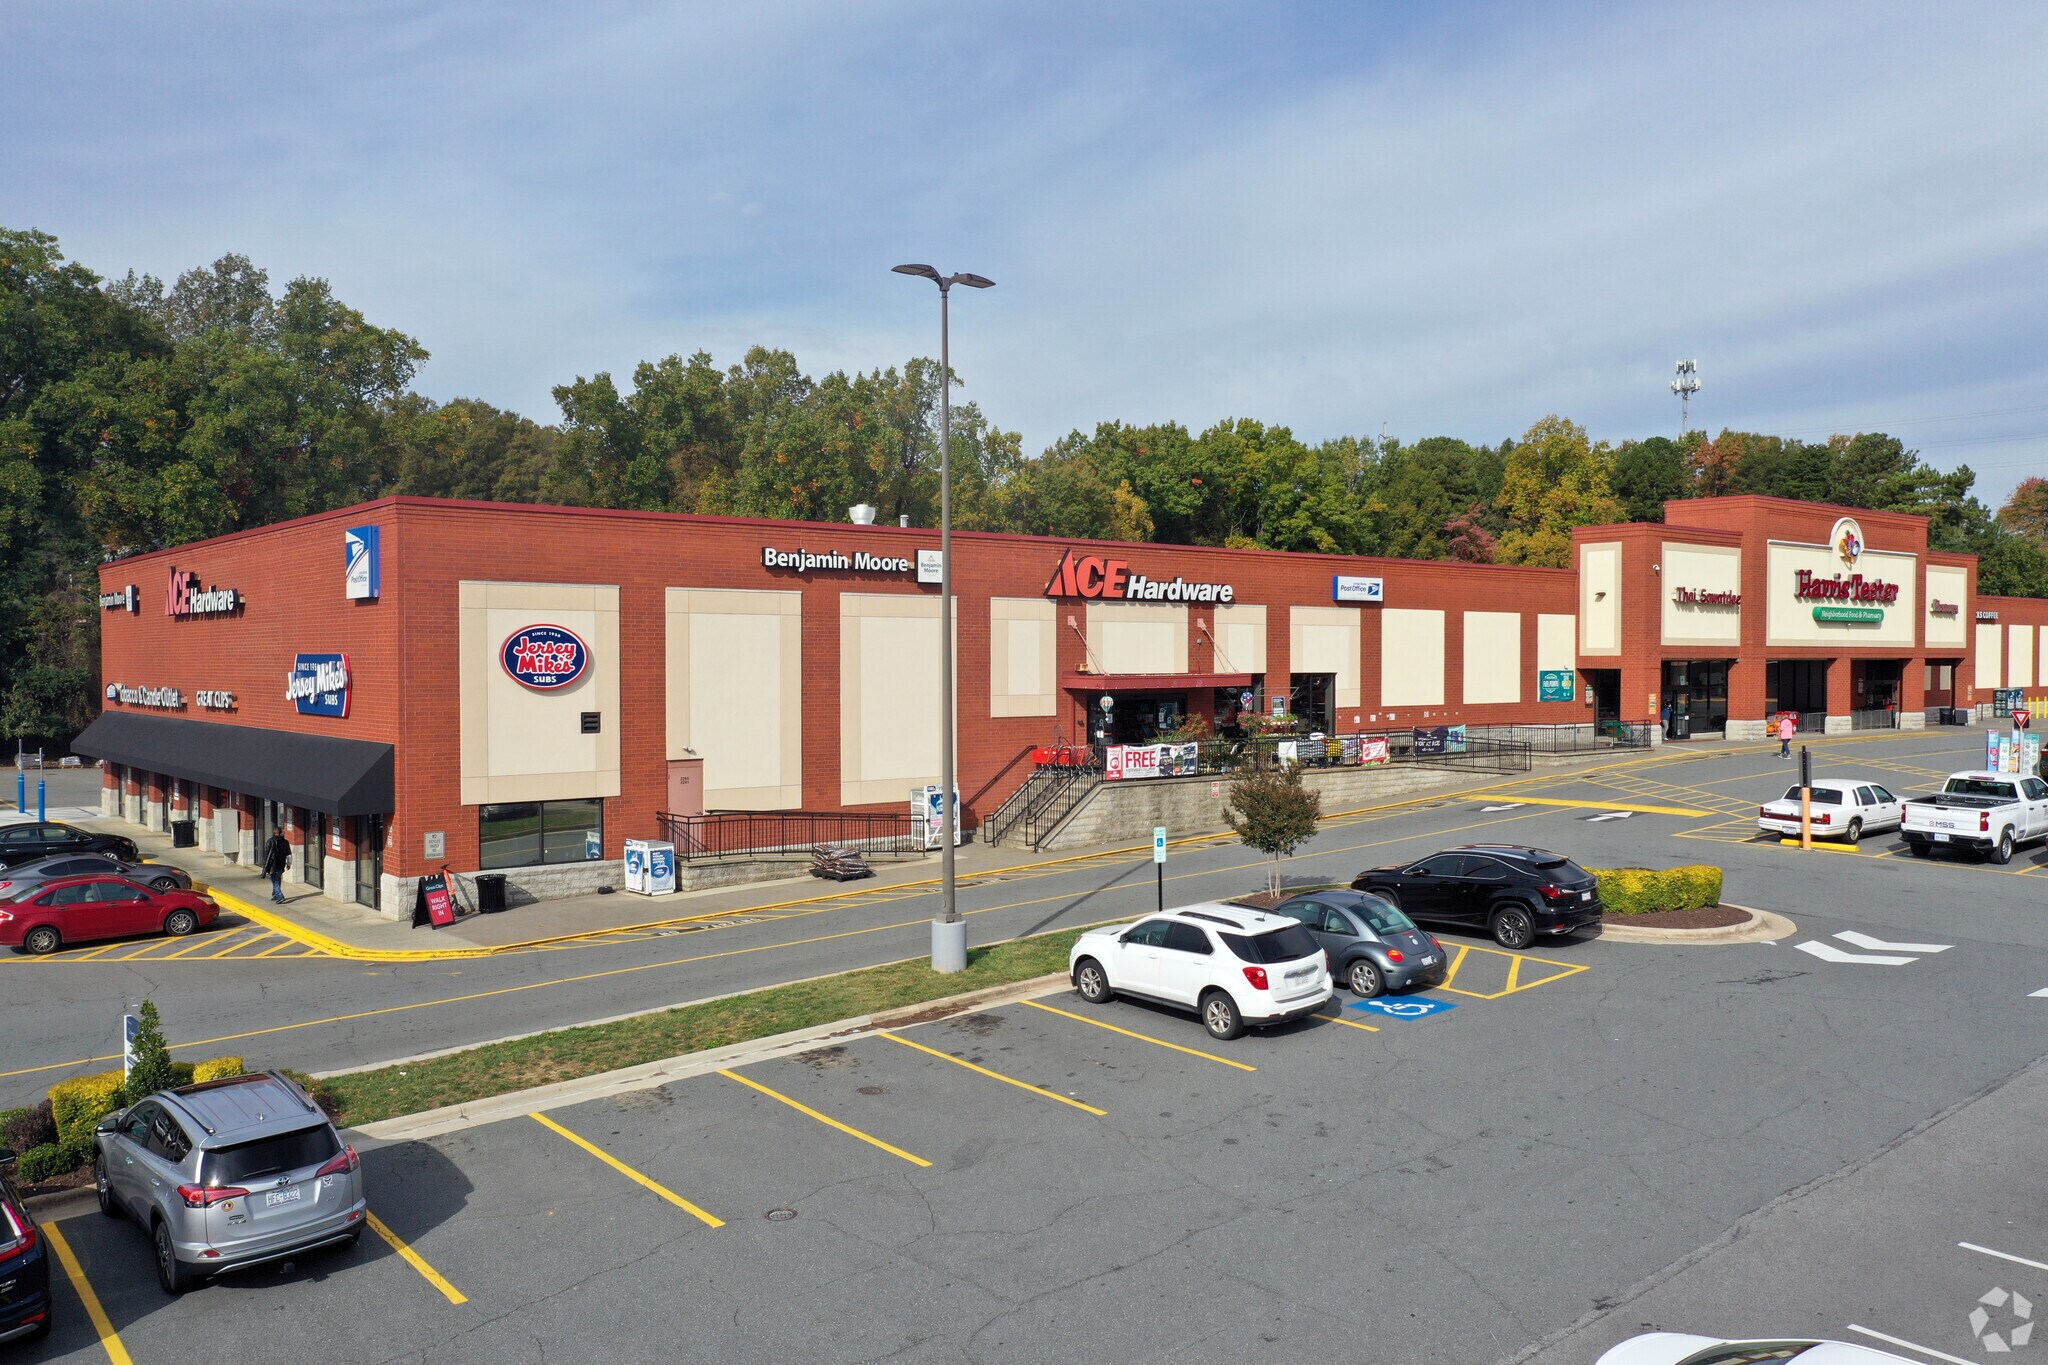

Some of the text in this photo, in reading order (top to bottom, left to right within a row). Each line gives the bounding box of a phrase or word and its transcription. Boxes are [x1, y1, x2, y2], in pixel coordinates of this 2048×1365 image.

[764, 547, 909, 572] Benjamin Moore
[1047, 550, 1234, 602] ACE Hardware
[165, 566, 234, 615] ACE Hardware
[1351, 585, 1367, 593] Office
[1796, 569, 1899, 602] Harris Teeter
[1675, 587, 1697, 603] Thai
[1863, 612, 1882, 620] Pharmacy
[1983, 611, 1999, 619] COFFEE
[513, 636, 576, 660] Jersey
[517, 655, 575, 675] Mike's
[286, 661, 346, 704] Jersey Mike's
[533, 675, 557, 683] SUBS
[196, 690, 213, 706] GREAT
[324, 694, 338, 706] SUBS
[1125, 750, 1156, 769] FREE
[430, 896, 446, 904] WALK
[431, 902, 447, 911] RIGHT
